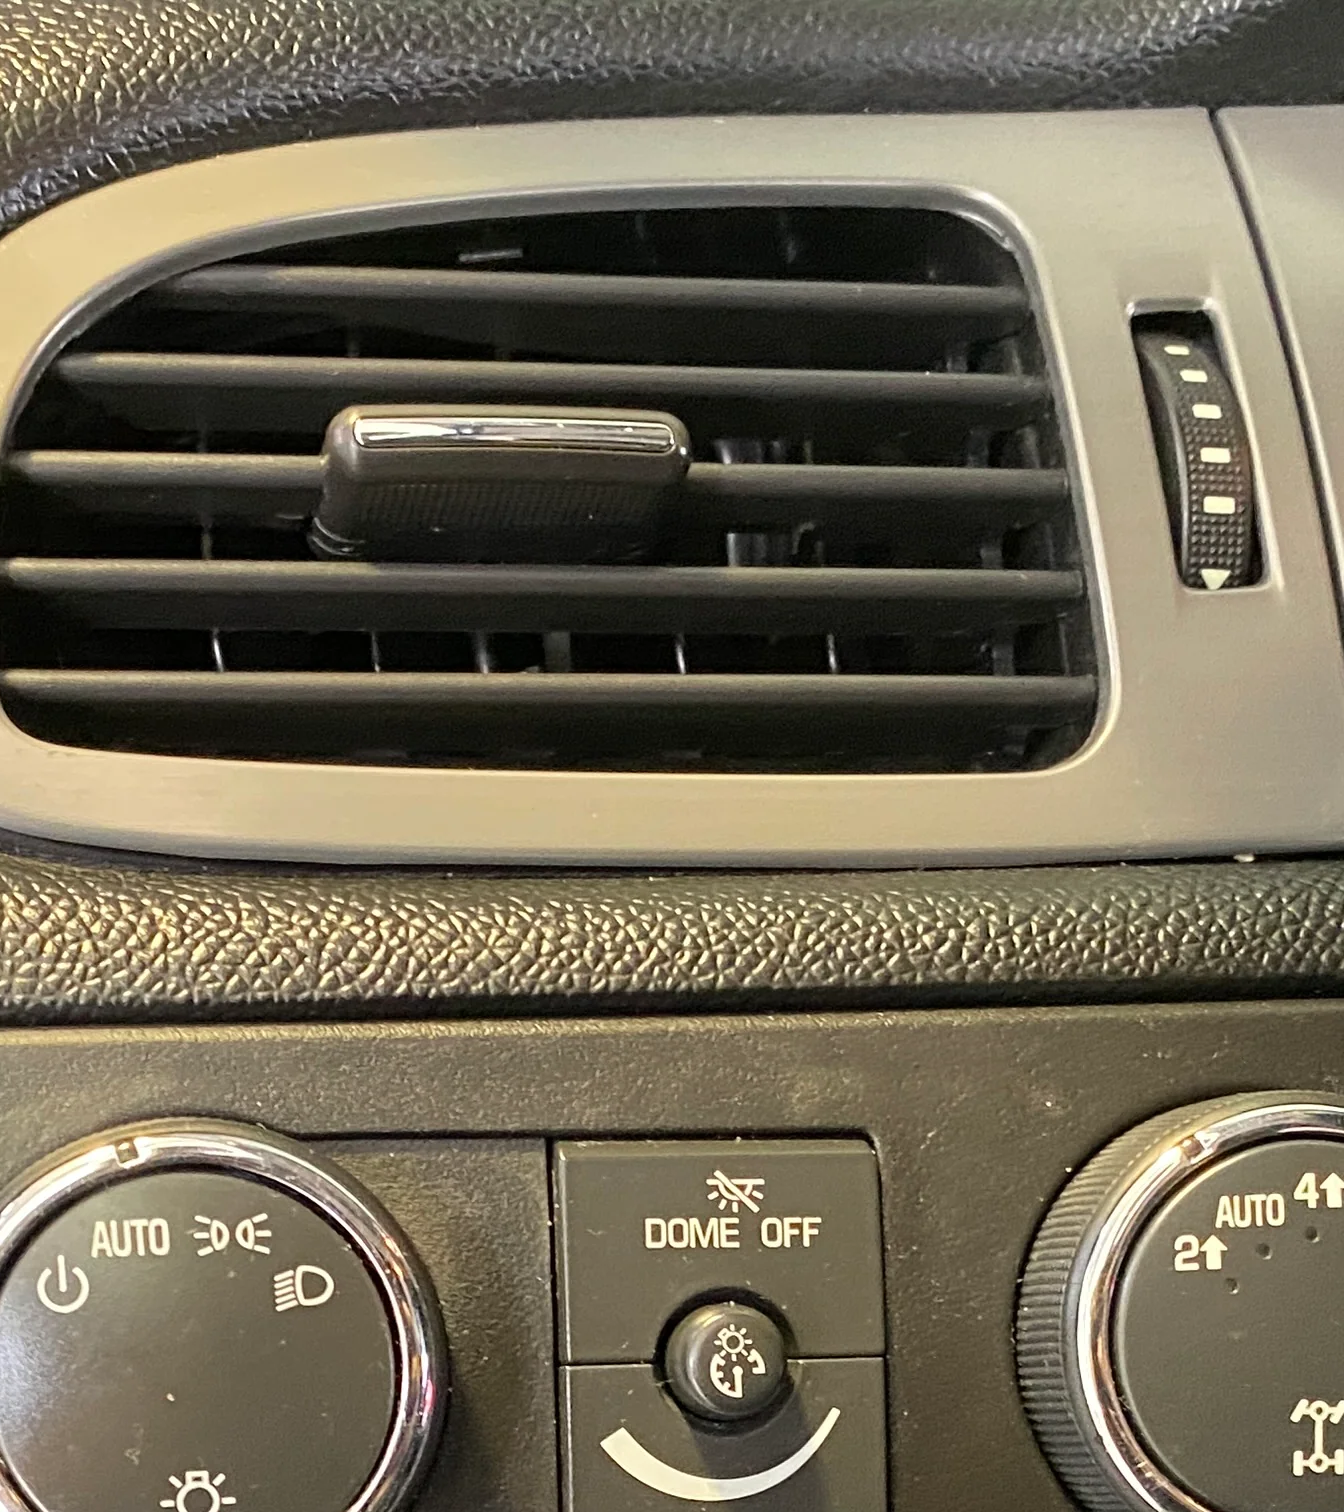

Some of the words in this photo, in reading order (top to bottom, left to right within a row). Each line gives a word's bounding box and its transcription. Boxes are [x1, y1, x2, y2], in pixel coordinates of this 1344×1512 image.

[1293, 1172, 1320, 1209] 4
[1215, 1193, 1286, 1228] AUTO
[90, 1217, 171, 1258] AUTO
[644, 1217, 741, 1249] DOME
[760, 1216, 822, 1248] OFF
[1173, 1234, 1201, 1272] 2
